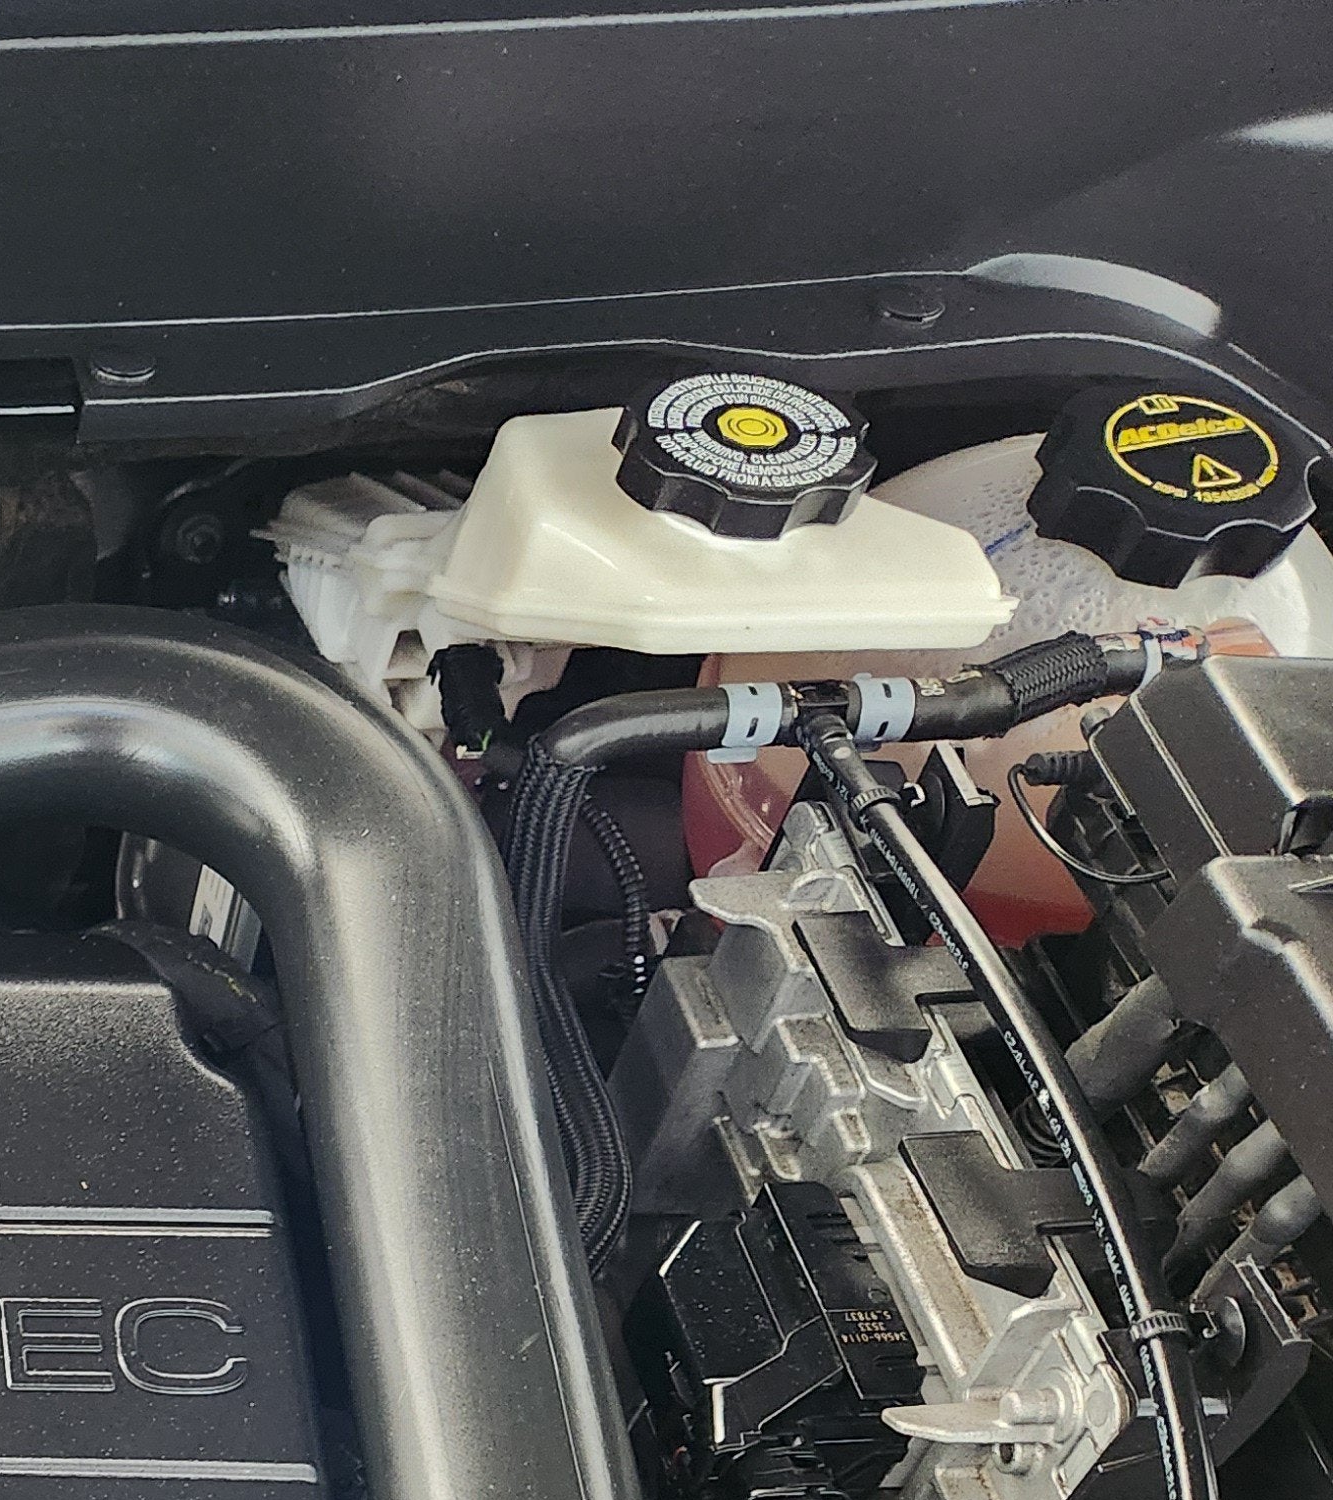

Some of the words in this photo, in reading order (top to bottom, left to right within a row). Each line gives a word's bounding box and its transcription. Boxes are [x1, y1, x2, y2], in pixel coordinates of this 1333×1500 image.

[730, 374, 786, 390] BOUCHON
[772, 389, 790, 402] DE
[690, 447, 741, 470] BEFORE
[750, 450, 795, 464] CLEAN
[678, 454, 718, 475] FLUID
[716, 469, 759, 485] FROM
[761, 476, 772, 487] A
[771, 470, 824, 487] SEALED
